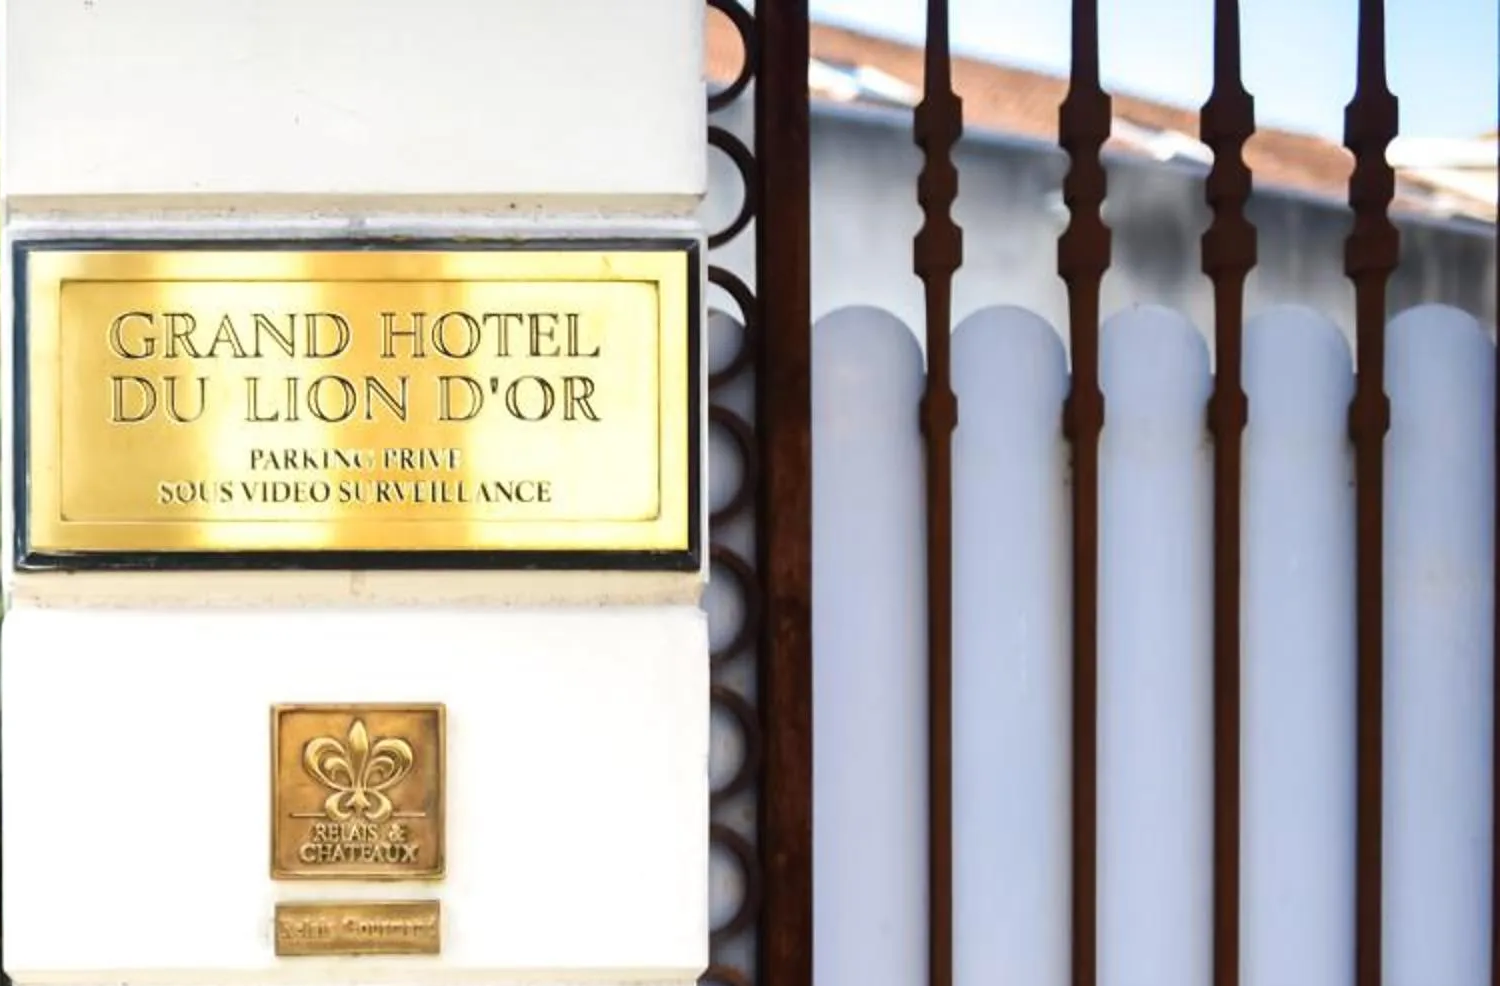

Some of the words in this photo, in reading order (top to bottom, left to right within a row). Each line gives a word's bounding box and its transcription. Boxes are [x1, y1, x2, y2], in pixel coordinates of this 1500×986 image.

[108, 310, 351, 359] GRAND
[380, 310, 601, 359] HOTEL
[110, 375, 210, 423] DU
[244, 375, 410, 423] LION
[436, 375, 603, 422] D'OR
[249, 448, 375, 470] PARKING
[159, 479, 234, 503] SOUS
[239, 481, 331, 503] VIDEO
[338, 479, 553, 503] SURVEILLANCE
[313, 822, 379, 842] RELAIS
[387, 822, 405, 842] &
[298, 842, 420, 863] CHATEAUX
